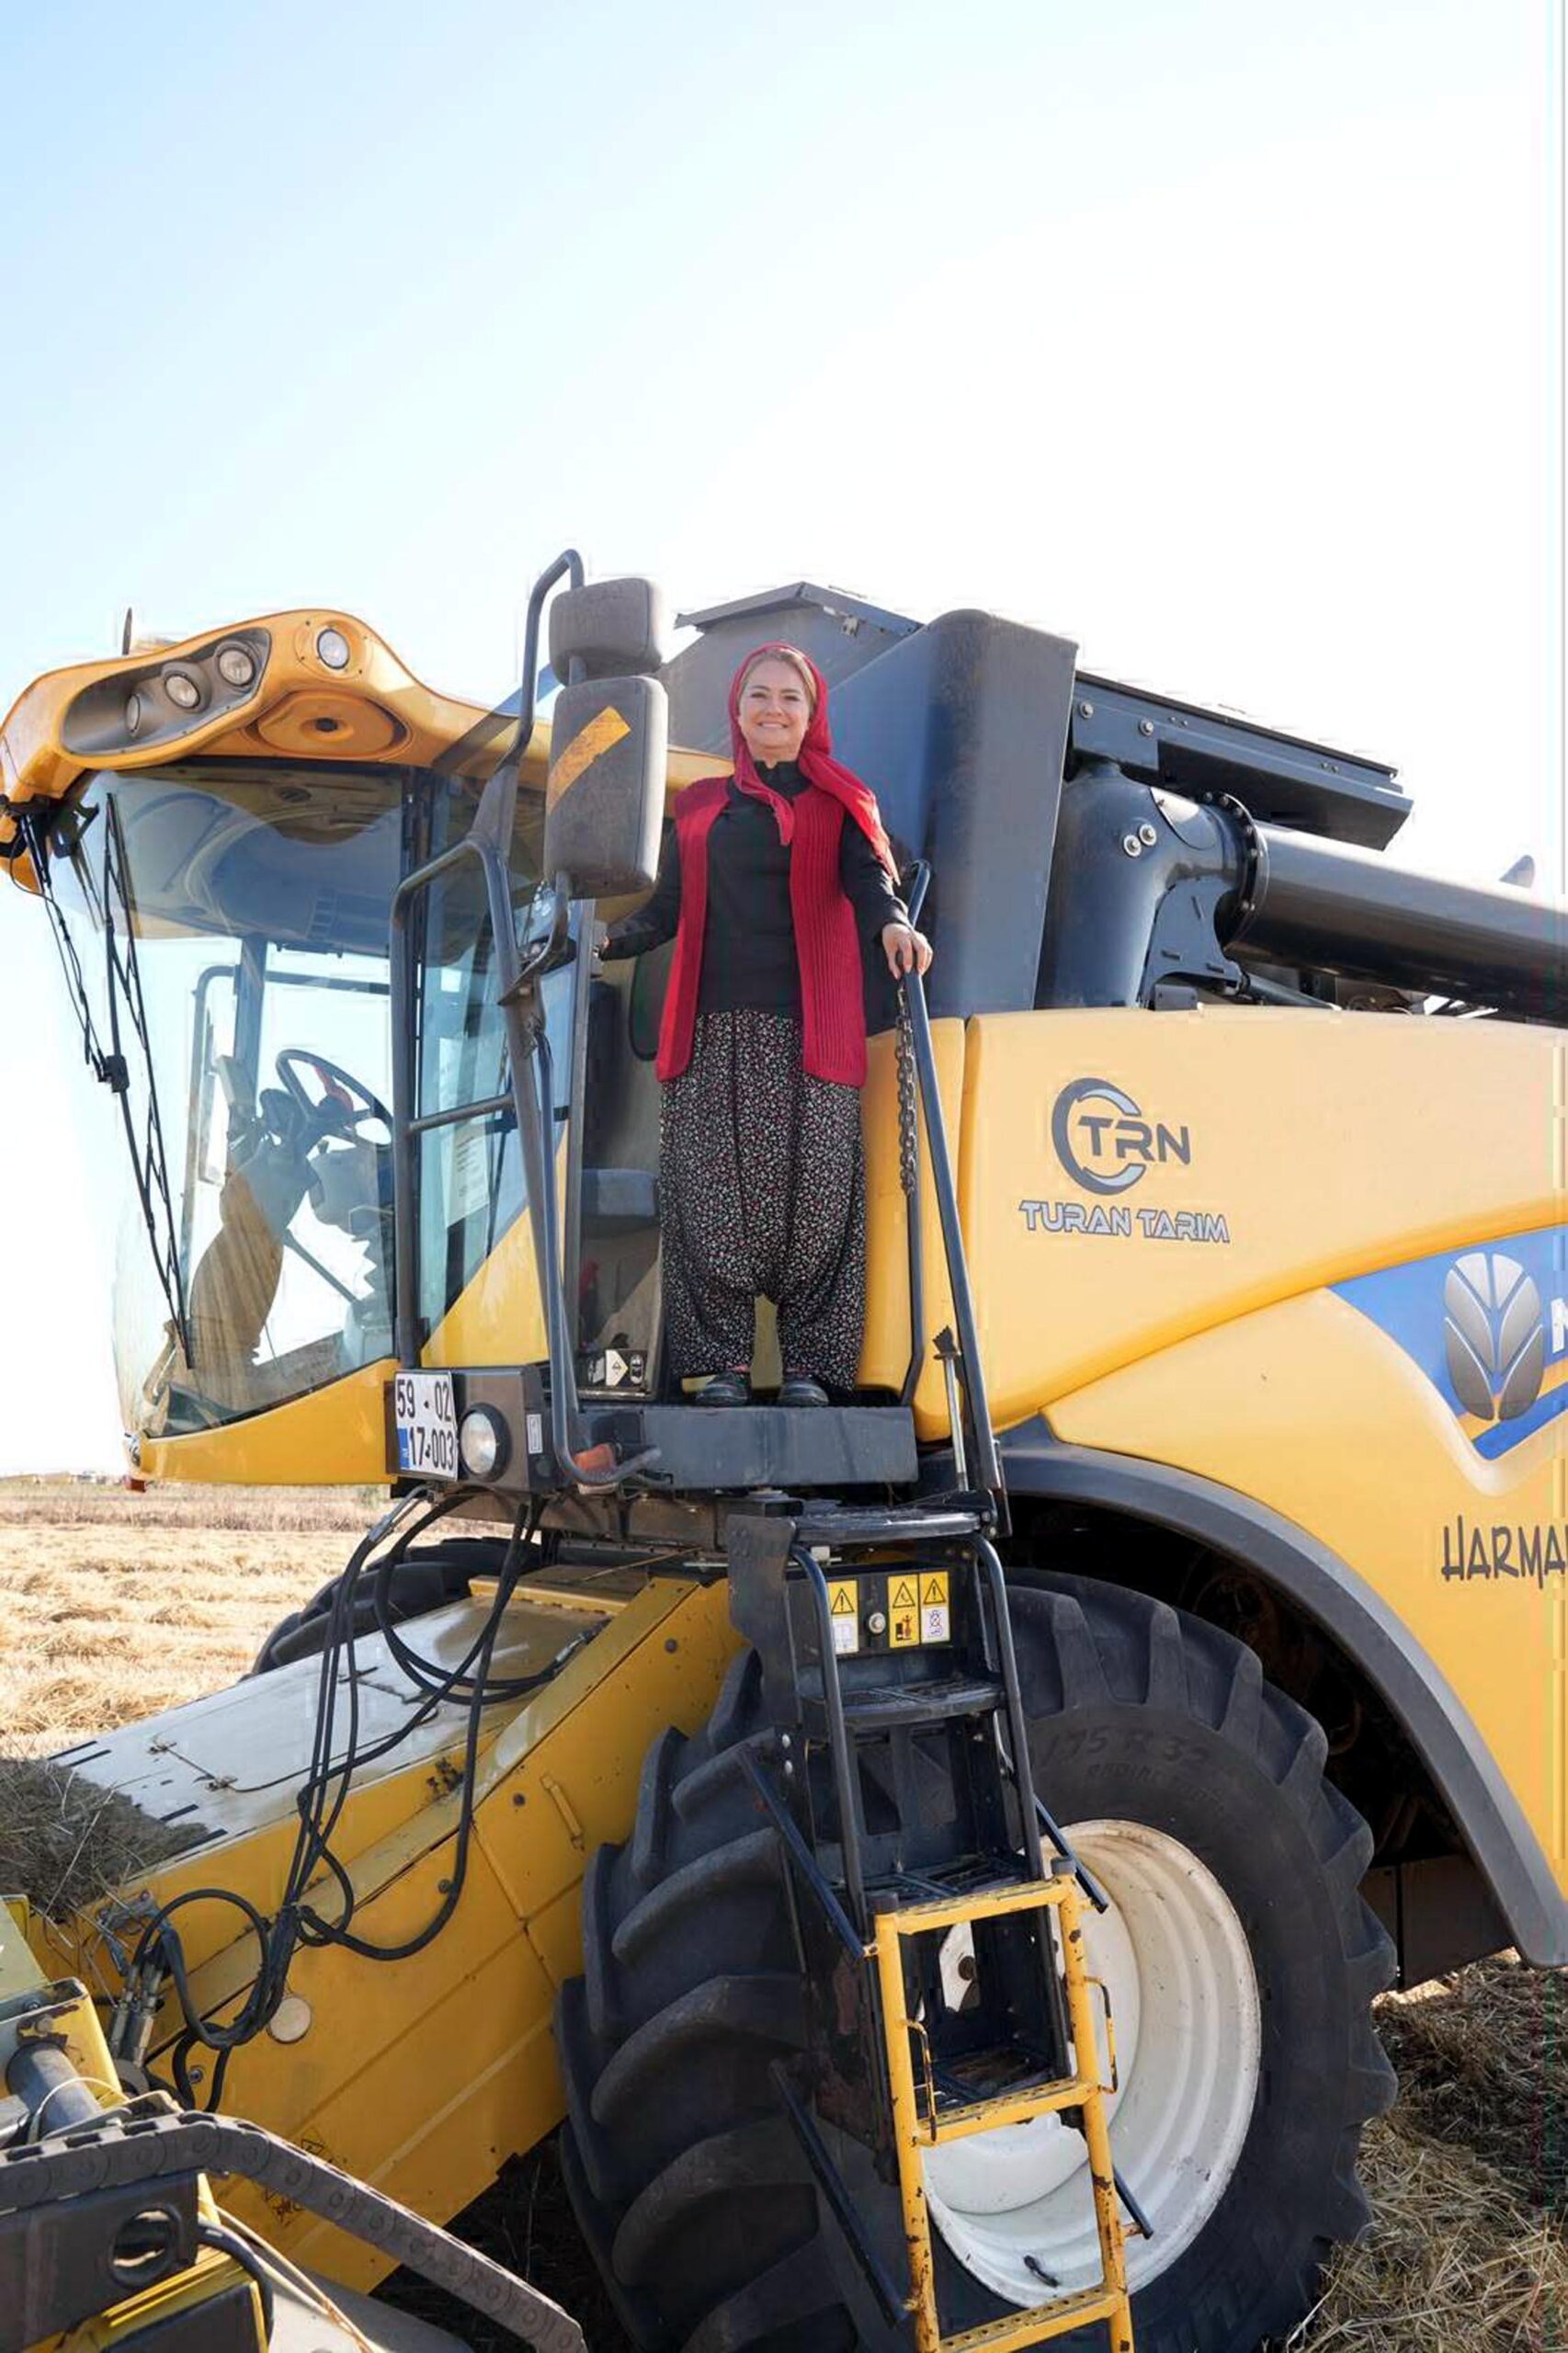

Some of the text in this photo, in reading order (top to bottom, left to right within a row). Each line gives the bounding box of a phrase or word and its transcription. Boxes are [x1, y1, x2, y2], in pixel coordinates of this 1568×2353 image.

[1018, 1199, 1231, 1244] TURAN TARIM
[397, 1380, 451, 1422] 59 02
[1441, 1515, 1568, 1589] HARMA
